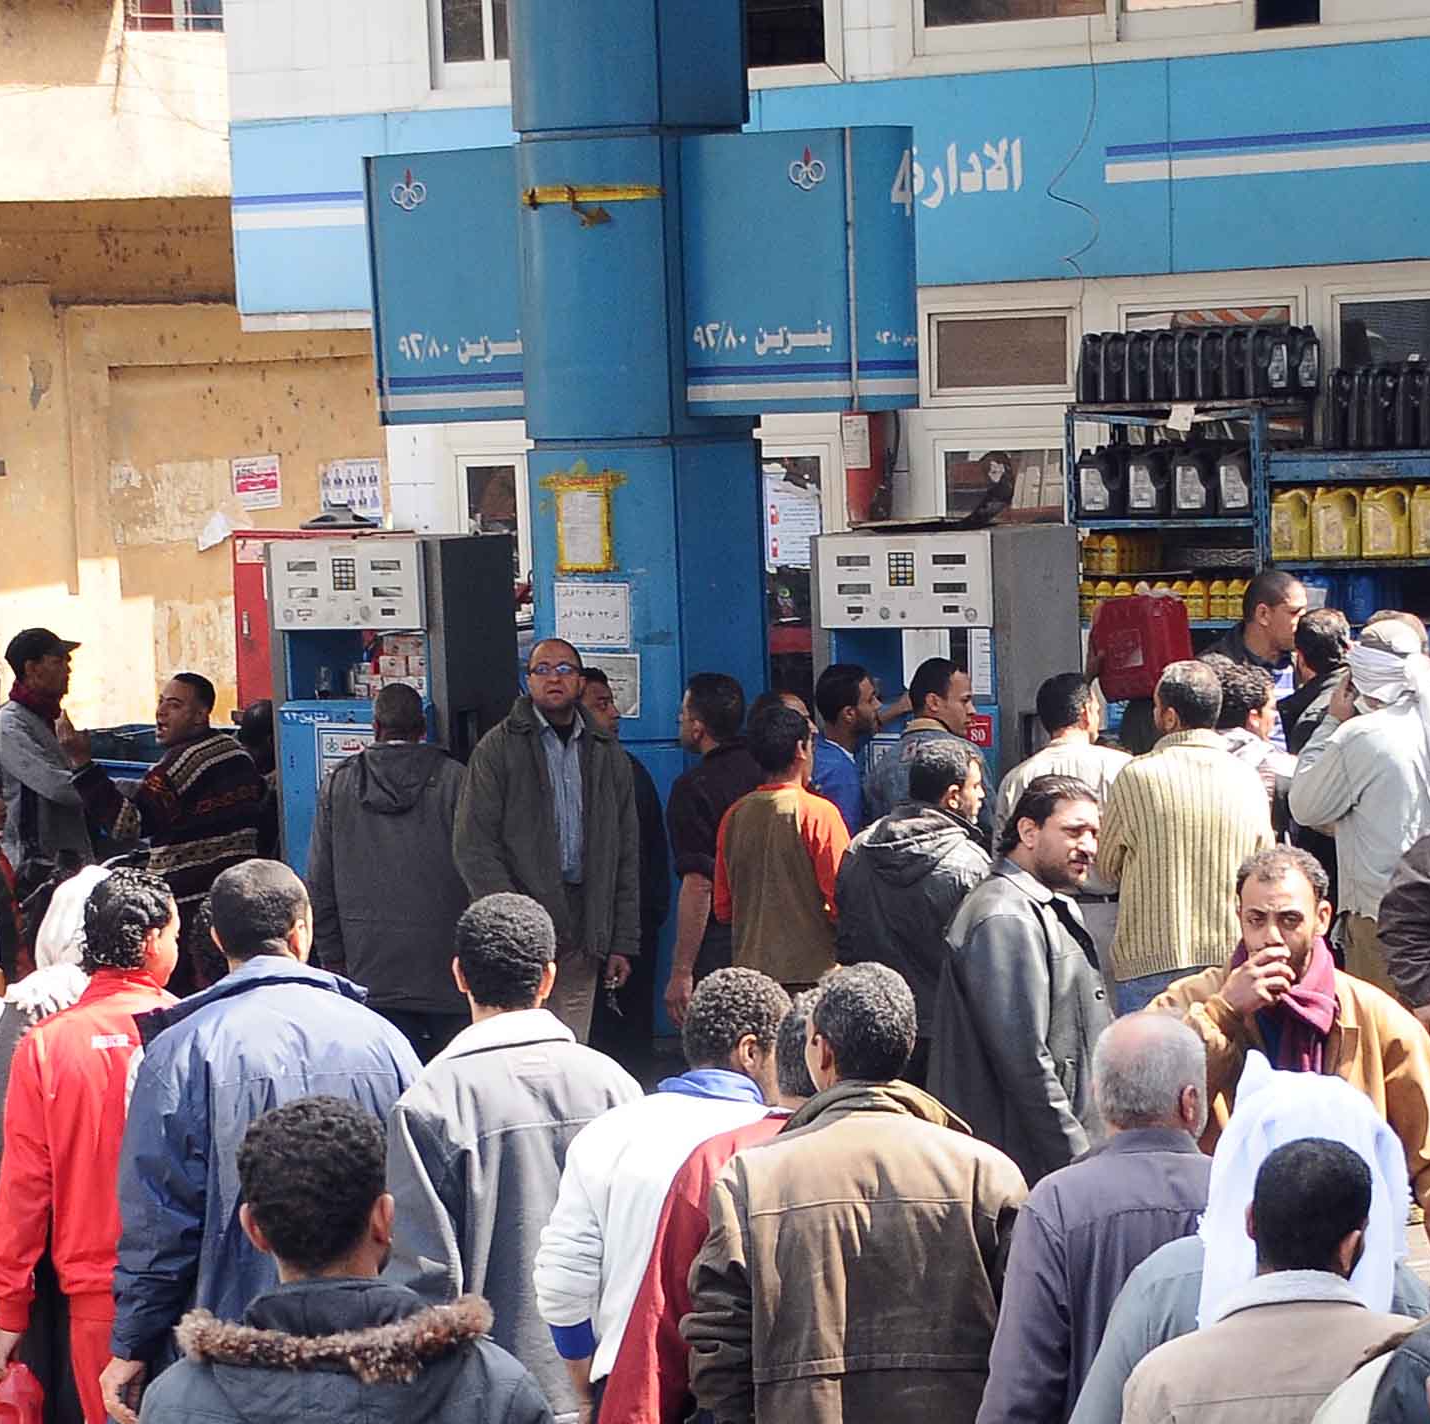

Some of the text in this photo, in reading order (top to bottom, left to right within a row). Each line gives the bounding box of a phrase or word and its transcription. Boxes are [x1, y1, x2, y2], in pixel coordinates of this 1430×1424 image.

[890, 149, 913, 217] 4
[457, 328, 523, 365] نزين
[755, 319, 832, 355] بنزين
